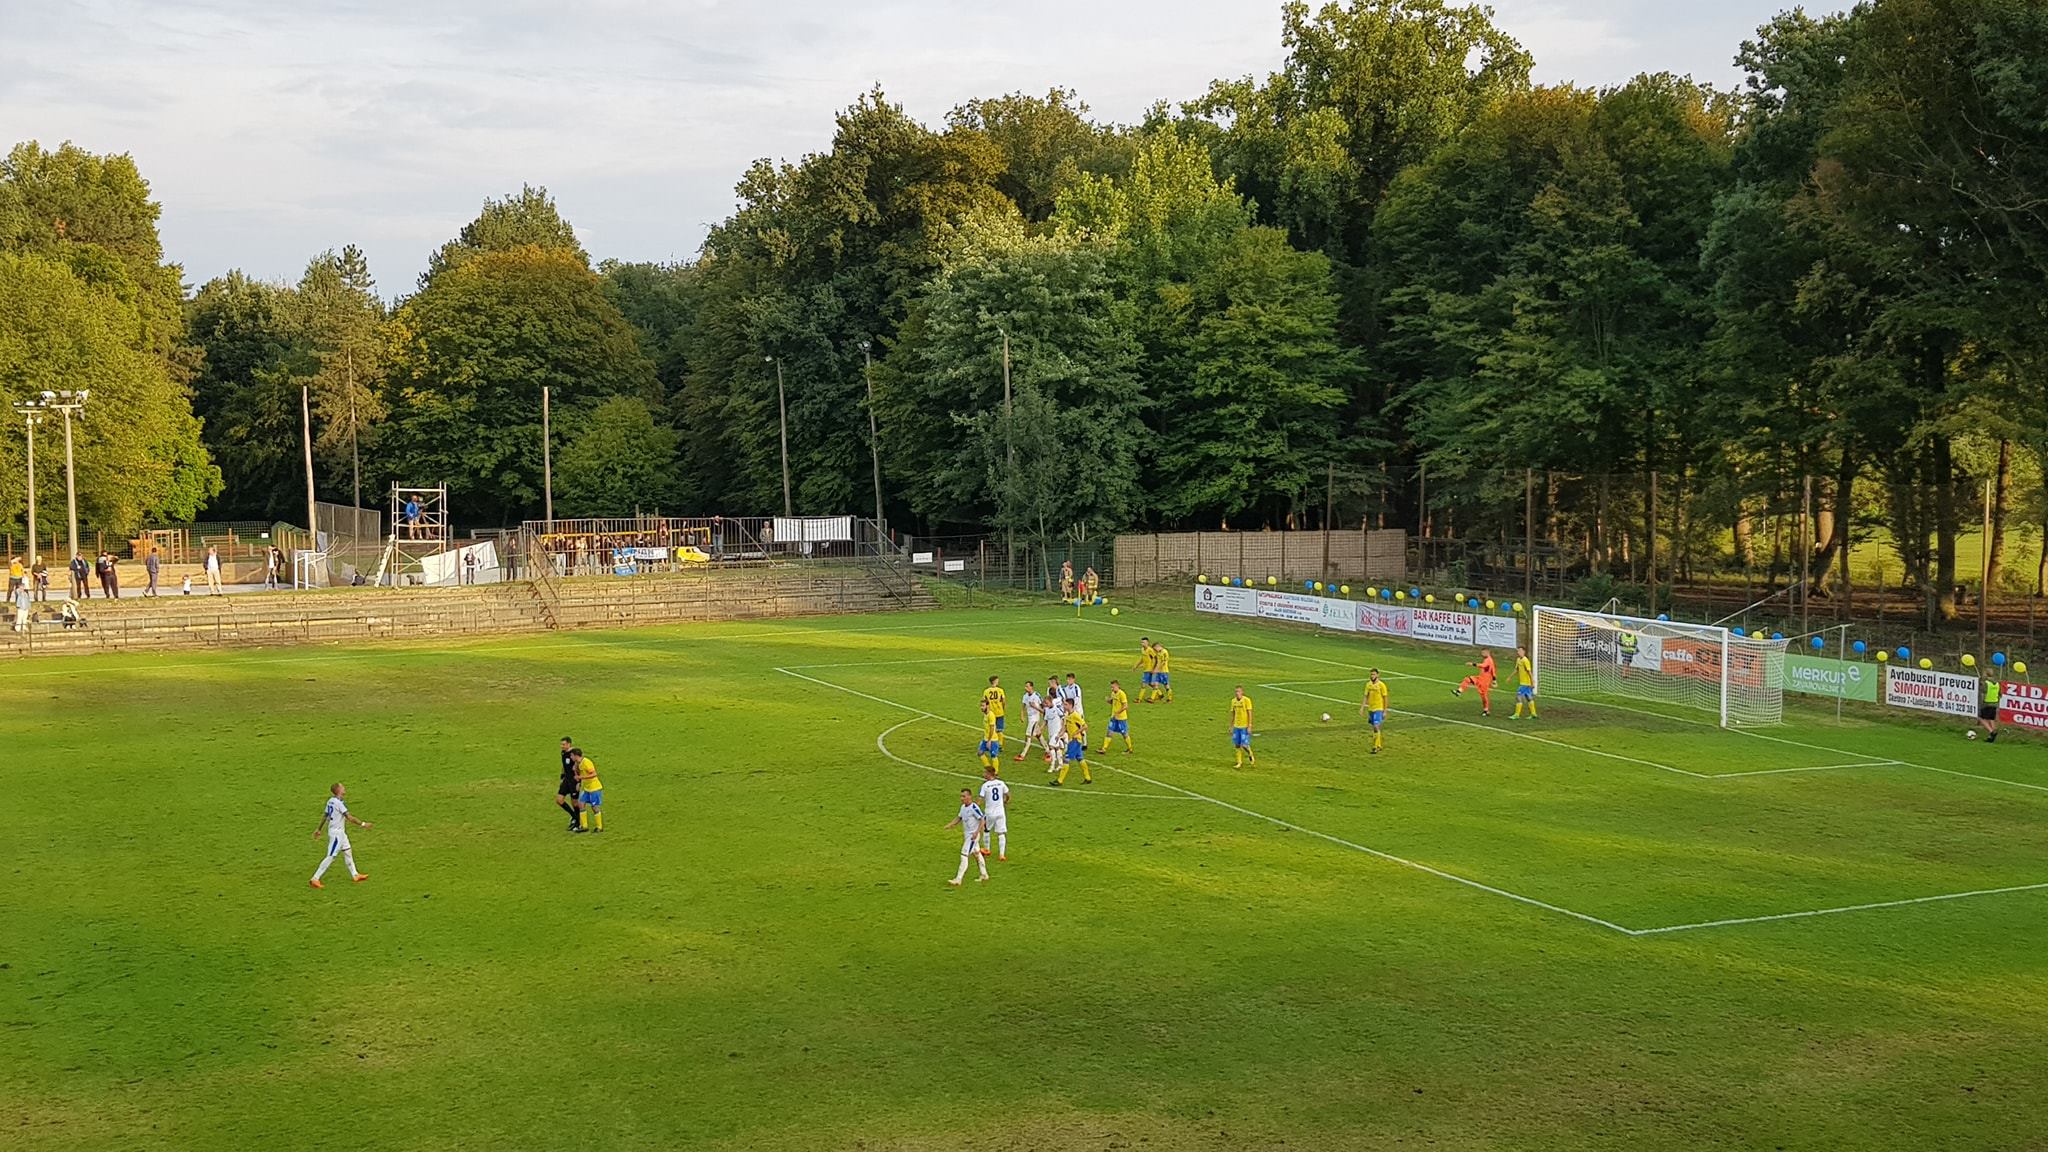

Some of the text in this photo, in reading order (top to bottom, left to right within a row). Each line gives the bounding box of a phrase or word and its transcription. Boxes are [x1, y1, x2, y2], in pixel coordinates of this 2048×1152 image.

[1413, 609, 1472, 626] BAR KAFFE LENA
[1662, 648, 1693, 662] caffe
[1890, 668, 1975, 690] Avtobusni prevozi
[989, 690, 998, 701] 20
[1893, 681, 1970, 703] SIMONITA d.o.o.
[2007, 699, 2048, 713] MAU
[992, 787, 999, 801] 8
